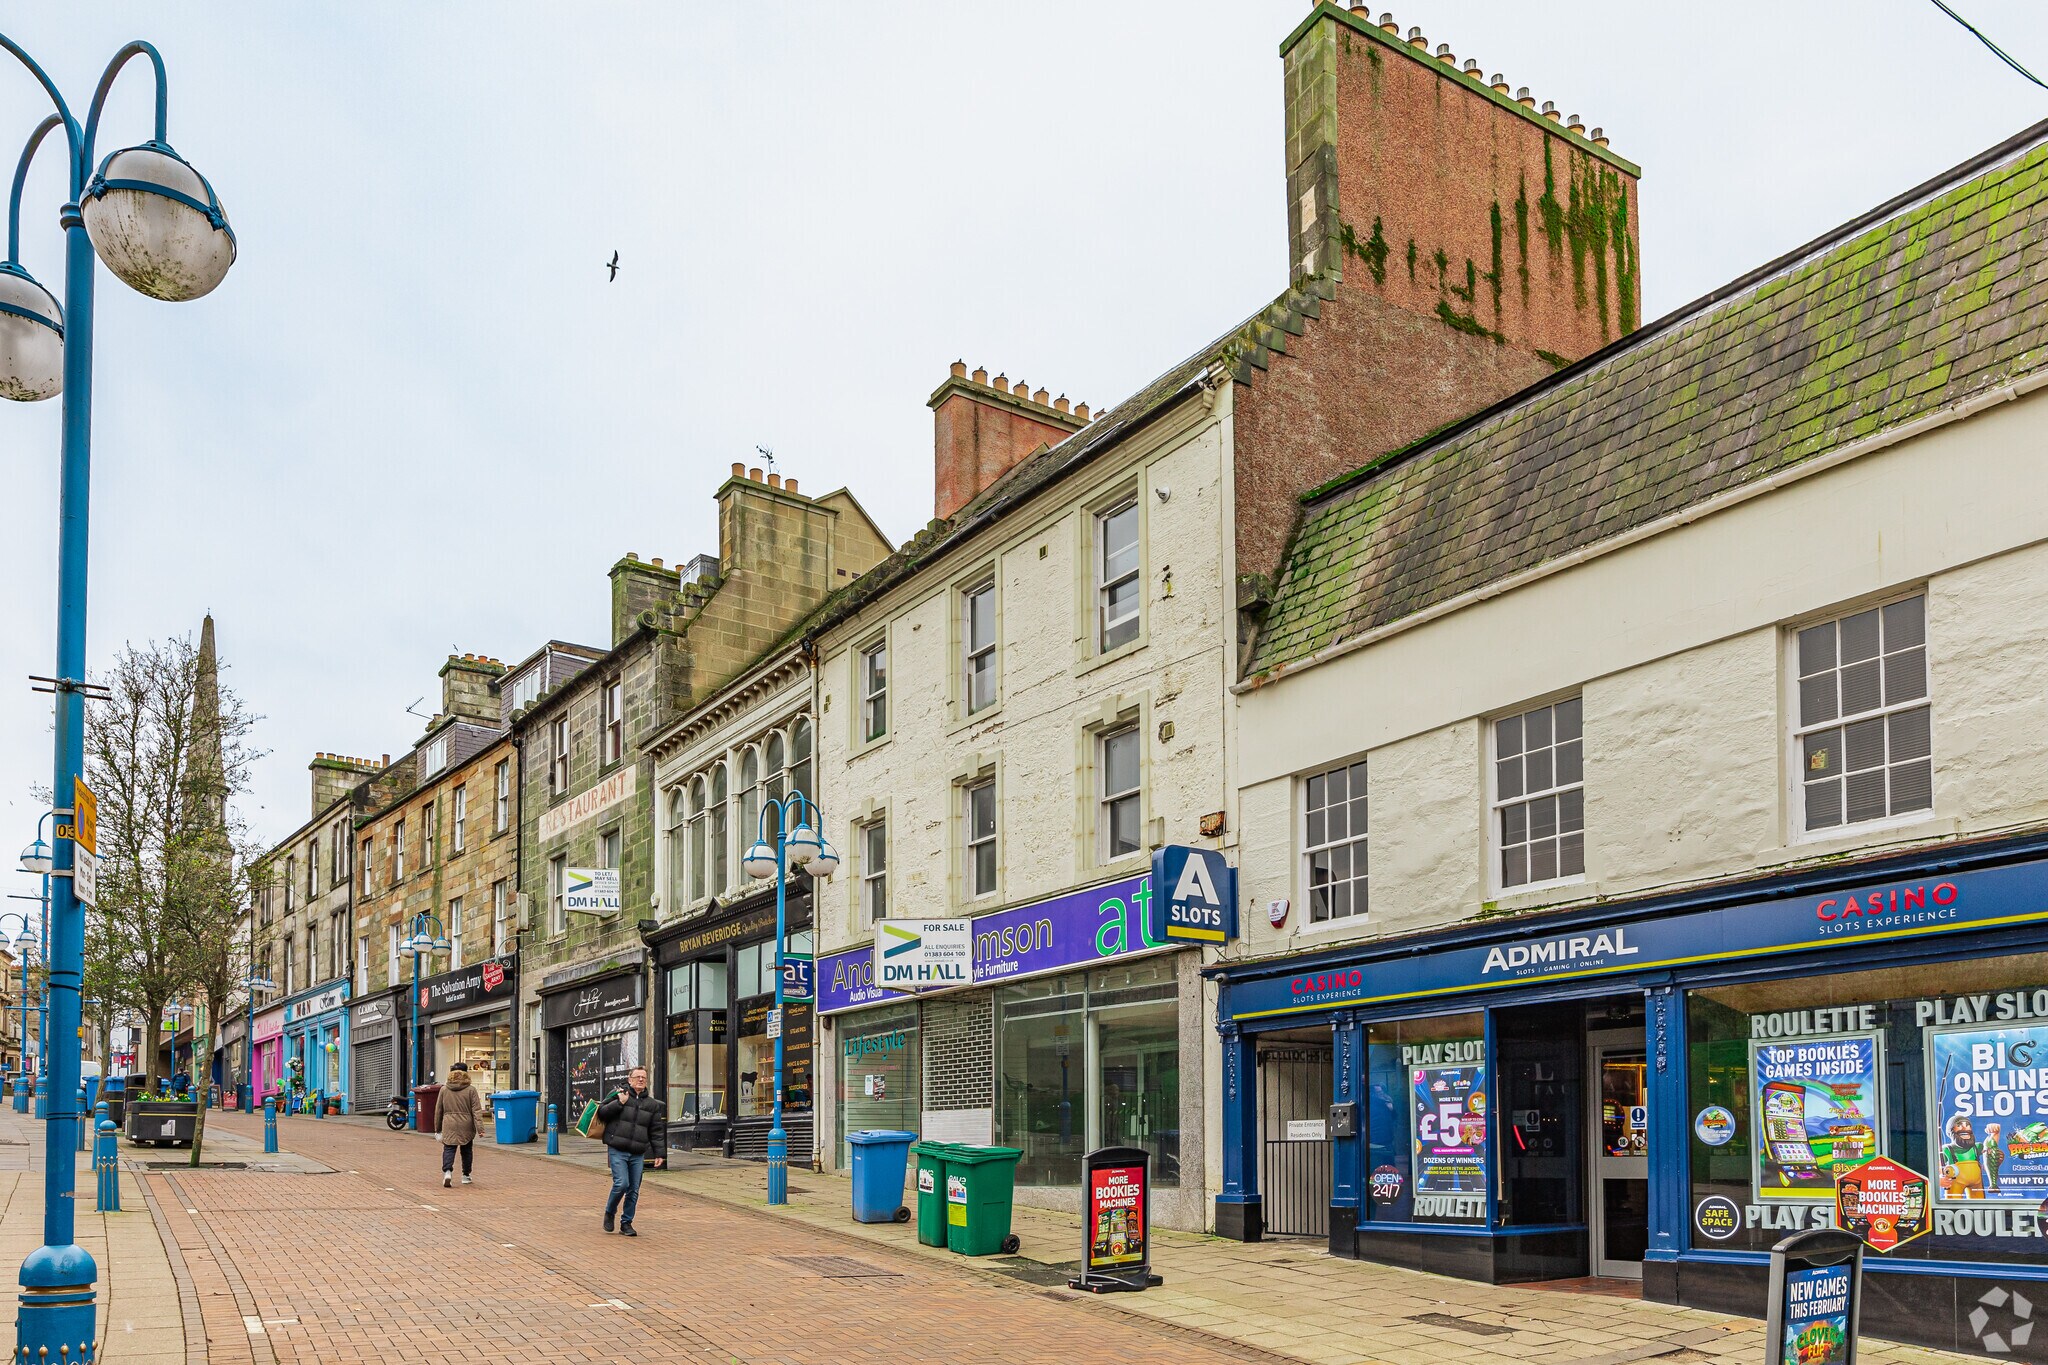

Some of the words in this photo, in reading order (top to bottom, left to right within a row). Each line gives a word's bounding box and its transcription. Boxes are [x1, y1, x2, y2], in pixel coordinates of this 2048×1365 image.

[546, 771, 627, 835] RESTAURANT
[1172, 852, 1220, 905] A
[568, 896, 587, 907] DM
[590, 896, 620, 908] HALL
[1816, 882, 1958, 921] CASINO
[1171, 905, 1221, 926] SLOTS
[1819, 921, 1860, 935] SLOTS
[1867, 908, 1957, 929] EXPERIENCE
[924, 924, 941, 932] FOR
[942, 923, 965, 932] SALE
[680, 938, 702, 954] BRYAN
[702, 922, 742, 946] BEVERIDGE
[1481, 928, 1639, 974] ADMIRAL
[783, 961, 808, 981] at
[884, 965, 914, 980] DM
[918, 963, 966, 980] HALL
[985, 959, 1019, 975] Furniture
[1516, 967, 1535, 976] SLOTS
[1543, 963, 1570, 972] GAMING
[1579, 958, 1604, 968] ONLINE
[431, 984, 442, 998] The
[442, 978, 465, 995] Salvation
[465, 975, 482, 990] Army
[1291, 969, 1363, 995] CASINO
[849, 989, 866, 1003] Audio
[866, 987, 883, 999] Visual
[1293, 994, 1314, 1004] SLOTS
[1316, 988, 1361, 1001] EXPERIENCE
[1915, 995, 1990, 1028] PLAY
[1995, 989, 2048, 1020] SLO
[1751, 1004, 1877, 1039] ROULETTE
[845, 1027, 906, 1065] Lifestyle
[1402, 1043, 1441, 1066] PLAY
[1444, 1039, 1486, 1063] SLOT
[1769, 1048, 1795, 1064] TOP
[1798, 1044, 1860, 1061] BOOKIES
[1766, 1062, 1813, 1079] GAMES
[1816, 1059, 1864, 1076] INSIDE
[1954, 1068, 2048, 1093] ONLINE
[1954, 1089, 2048, 1117] SLOTS
[1832, 1149, 1864, 1159] BANK
[1833, 1141, 1864, 1149] ACTION
[2008, 1143, 2030, 1157] BIG
[1108, 1175, 1129, 1185] MORE
[1374, 1173, 1400, 1183] OPEN
[1867, 1180, 1897, 1191] MORE
[2000, 1177, 2018, 1185] WIN
[2019, 1177, 2033, 1185] UP
[2034, 1177, 2044, 1185] TO
[1095, 1184, 1140, 1200] BOOKIES
[1373, 1183, 1400, 1199] 24/7
[1859, 1191, 1906, 1203] BOOKIES
[1099, 1197, 1136, 1209] MACHINES
[1857, 1204, 1908, 1216] MACHINES
[1702, 1217, 1733, 1226] SPACE
[1705, 1209, 1729, 1218] SAFE
[1745, 1205, 1808, 1230] PLAY
[1790, 1281, 1814, 1303] NEW
[1815, 1275, 1848, 1299] GAMES
[1790, 1302, 1808, 1320] THIS
[1809, 1296, 1847, 1317] FEBRUARY
[1807, 1343, 1825, 1358] FLIP
